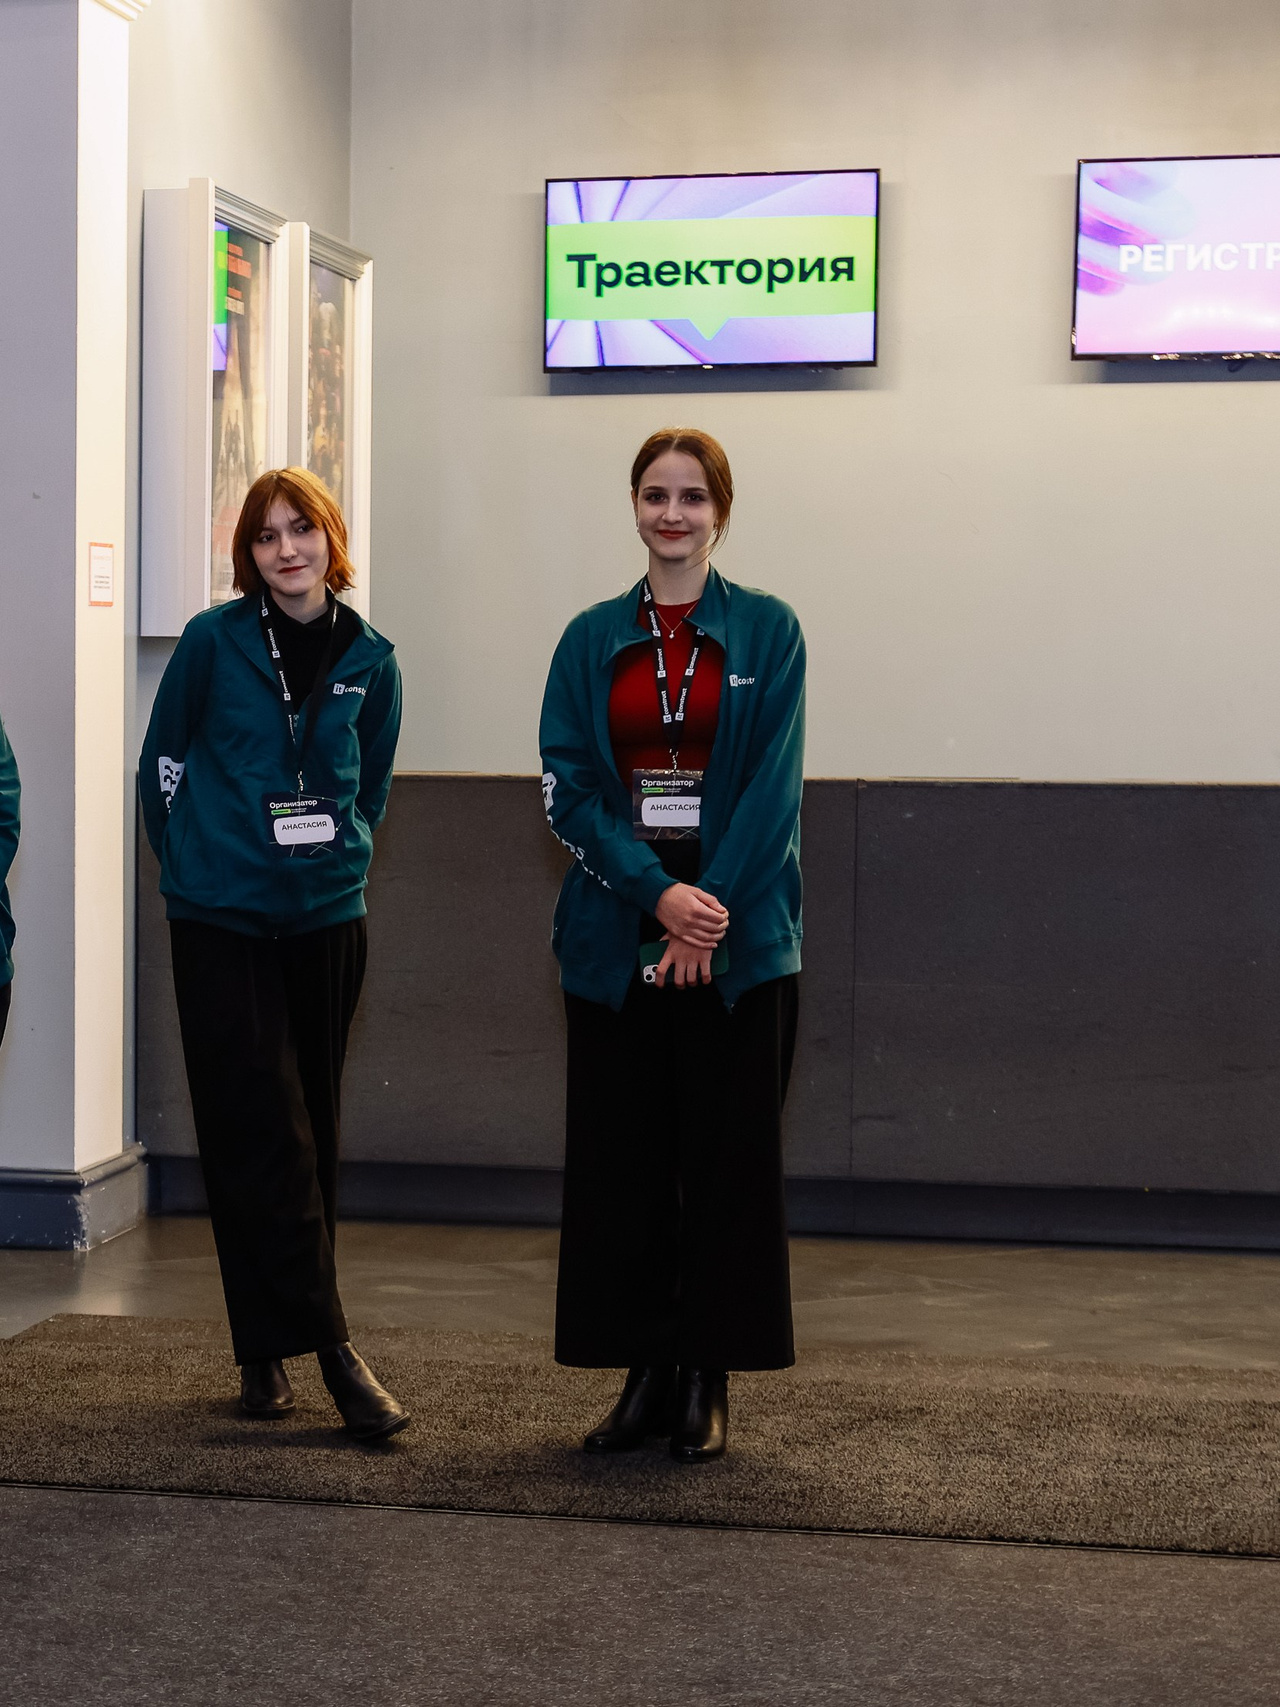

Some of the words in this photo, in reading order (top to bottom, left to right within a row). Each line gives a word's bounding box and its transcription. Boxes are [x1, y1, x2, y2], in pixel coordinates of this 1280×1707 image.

[566, 252, 855, 297] Траектория
[641, 778, 694, 788] Организатор
[269, 800, 318, 809] Организатор
[650, 803, 700, 811] АНАСТАСИЯ
[282, 820, 327, 831] АНАСТАСИЯ
